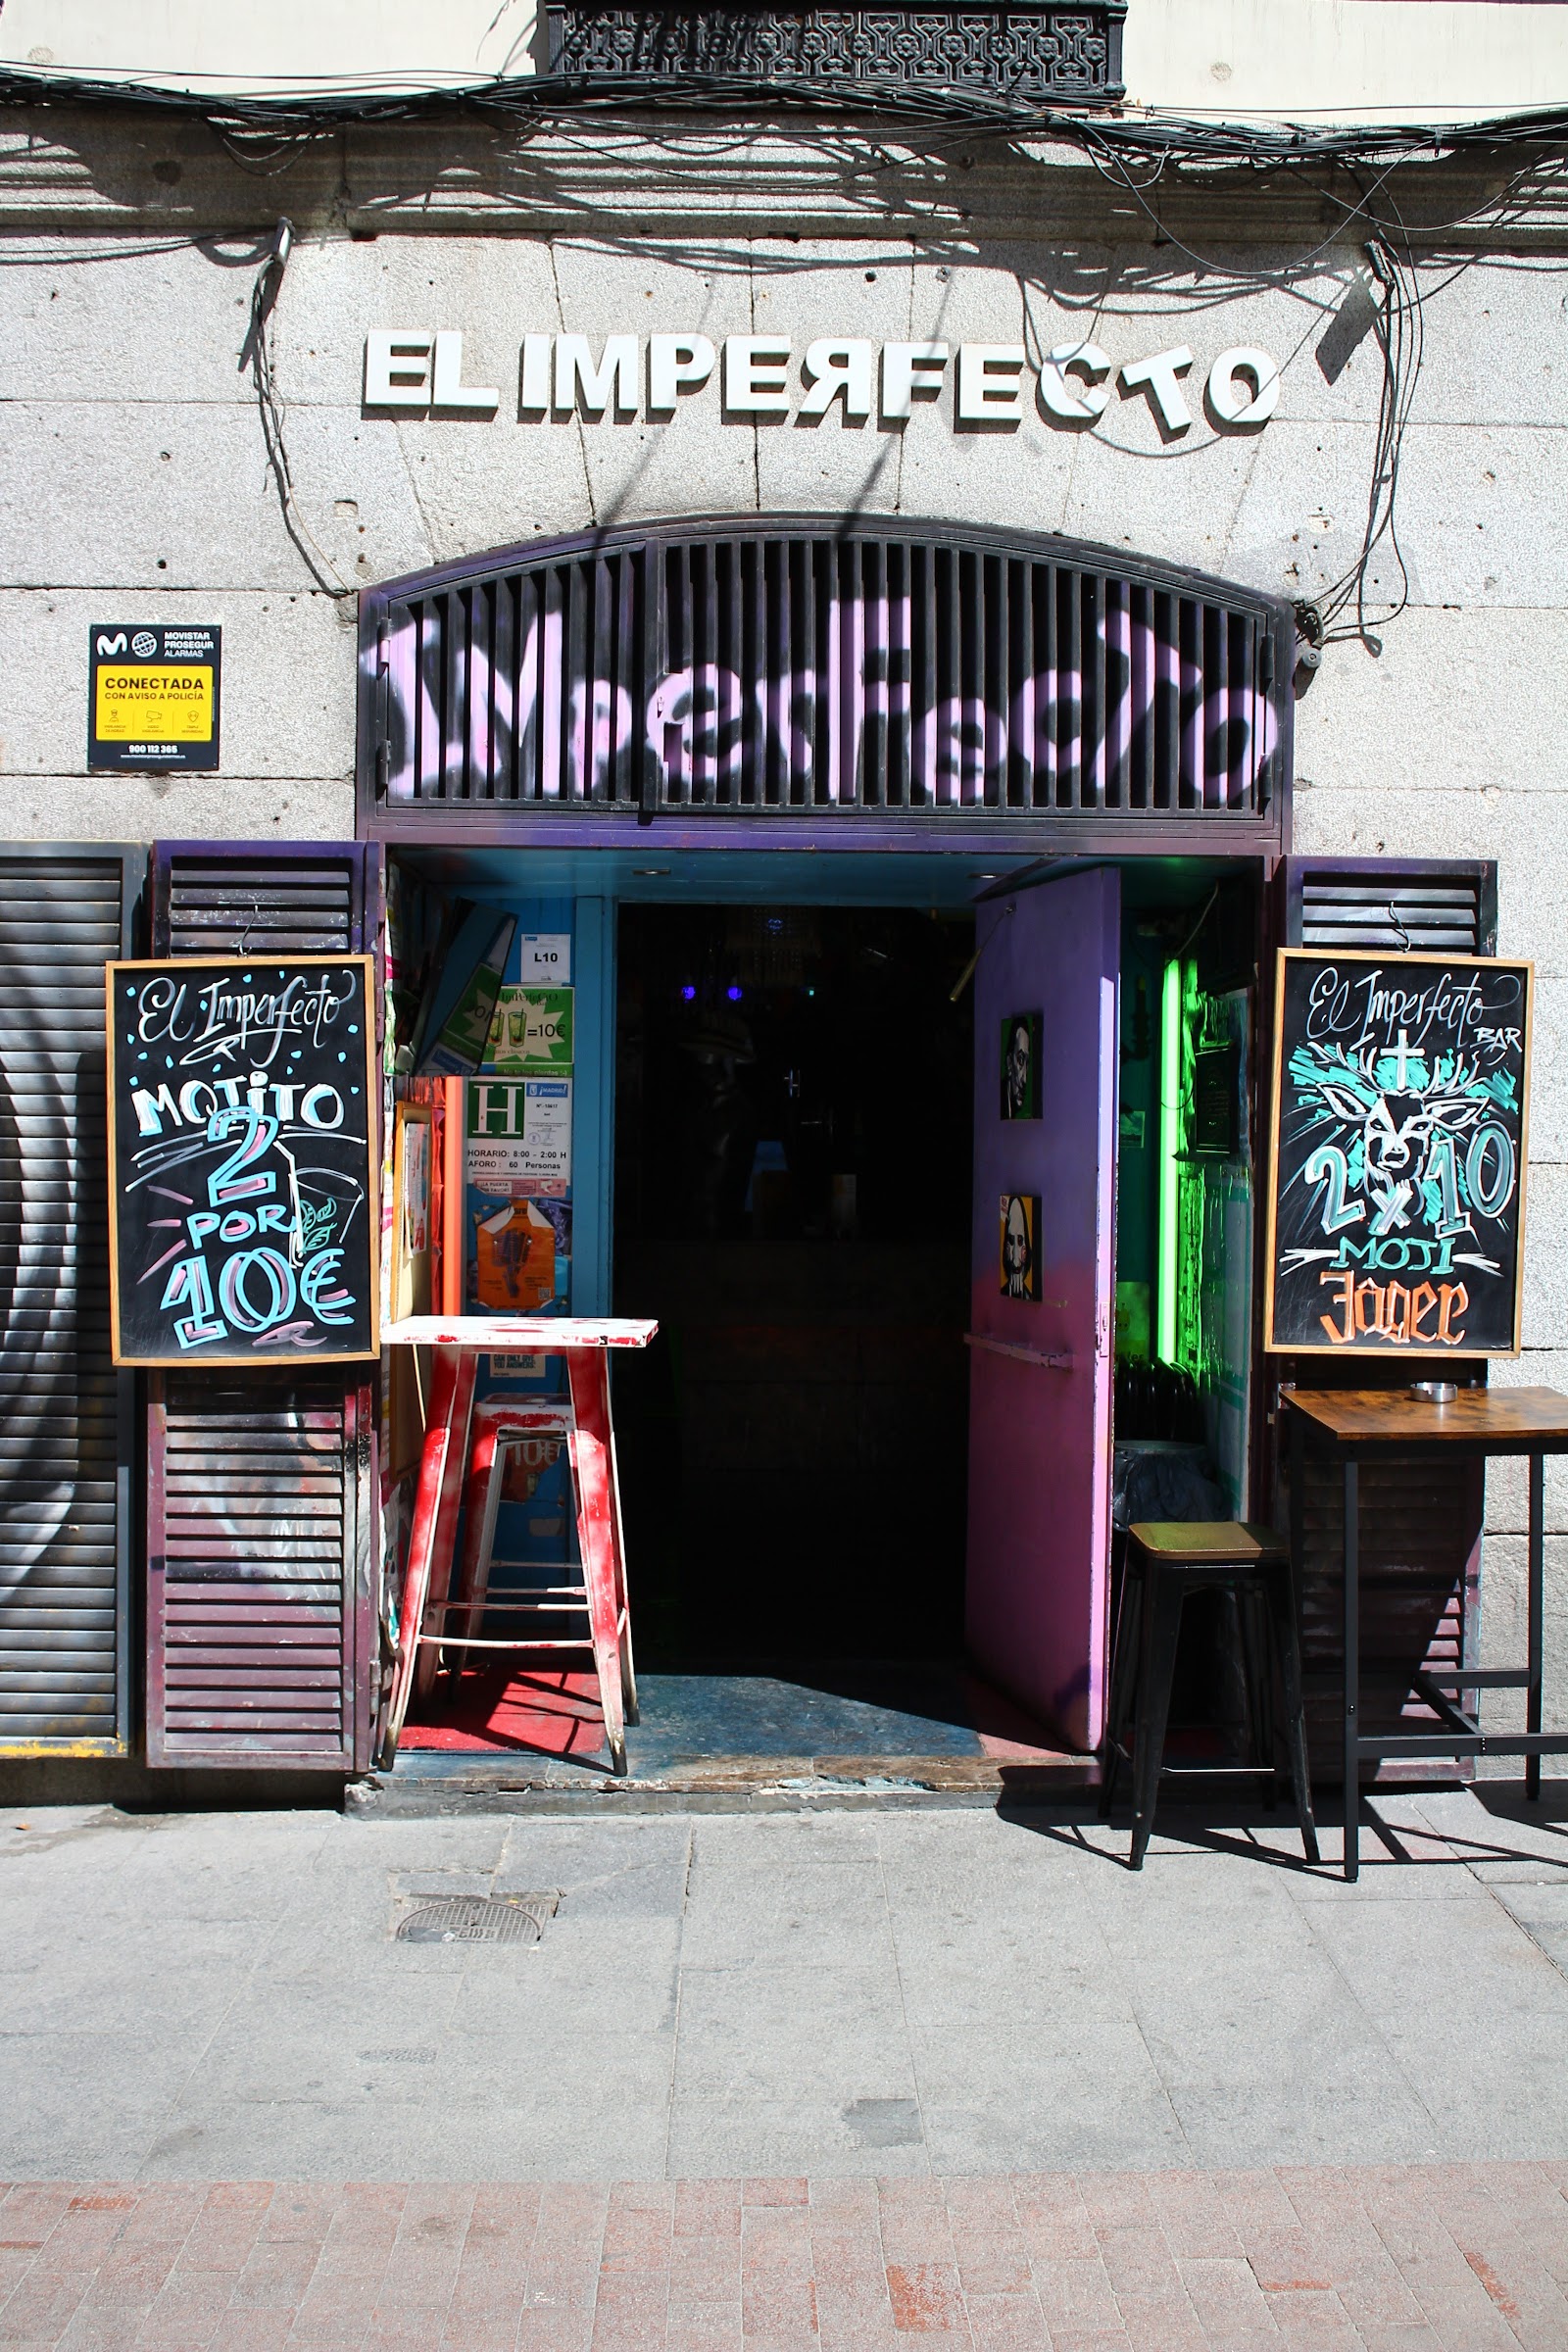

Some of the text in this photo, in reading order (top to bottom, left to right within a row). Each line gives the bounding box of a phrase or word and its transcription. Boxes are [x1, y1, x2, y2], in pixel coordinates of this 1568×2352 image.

[362, 328, 500, 419] EL
[164, 641, 214, 650] PROSEGUR
[105, 677, 204, 690] CONECTADA
[168, 690, 204, 700] POLICÍA
[128, 745, 177, 754] 900 112 365
[534, 953, 559, 962] L10
[137, 970, 357, 1068] El Imperfecto
[1305, 967, 1521, 1050] El Imperfecto
[1470, 1026, 1523, 1053] BAR
[472, 1085, 522, 1134] H
[207, 1105, 279, 1207] 2
[1304, 1145, 1367, 1235] 2
[1424, 1119, 1516, 1240] 10
[186, 1203, 298, 1250] POR
[1329, 1237, 1455, 1275] MOJI
[160, 1247, 357, 1349] 10€
